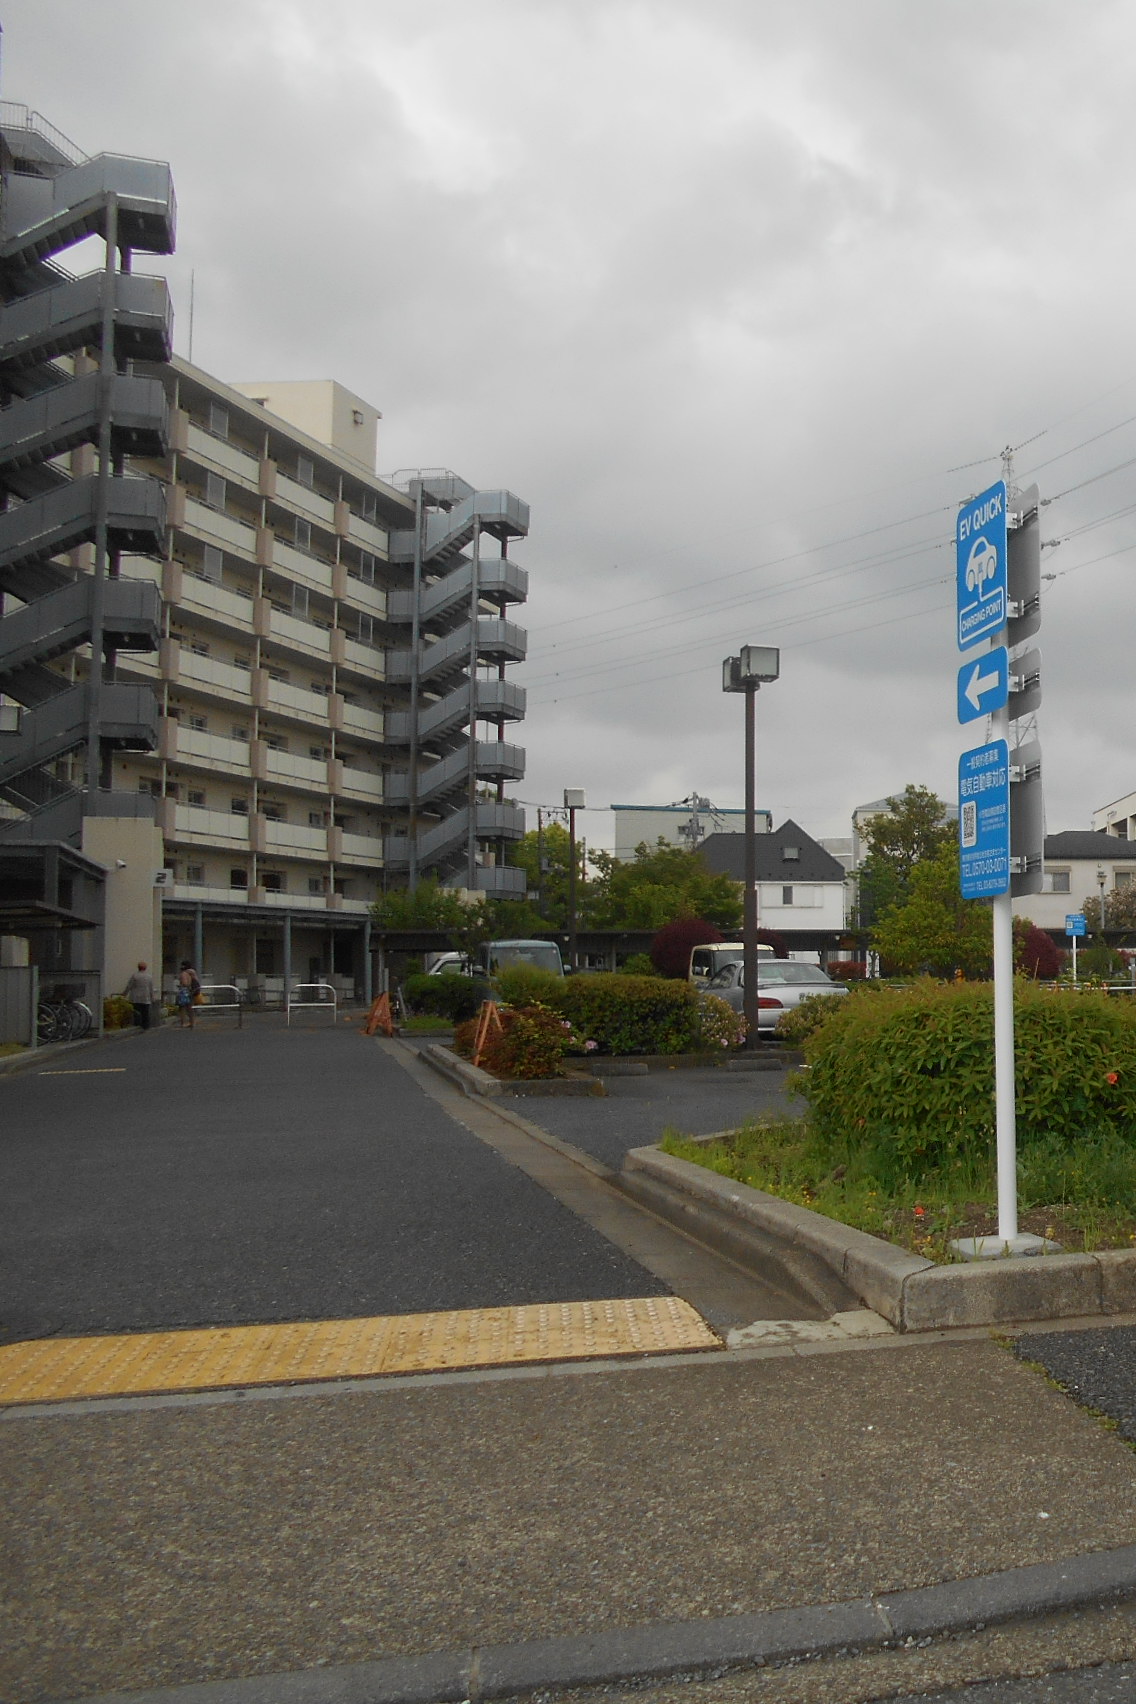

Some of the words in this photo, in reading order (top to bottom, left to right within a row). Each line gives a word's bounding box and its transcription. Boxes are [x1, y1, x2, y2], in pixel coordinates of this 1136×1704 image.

[960, 517, 971, 541] EV
[973, 492, 1002, 531] QUICK
[962, 608, 986, 633] CHARGING
[985, 599, 1002, 618] POINT
[960, 767, 1006, 797] 電気自動車対応
[155, 872, 167, 883] 2
